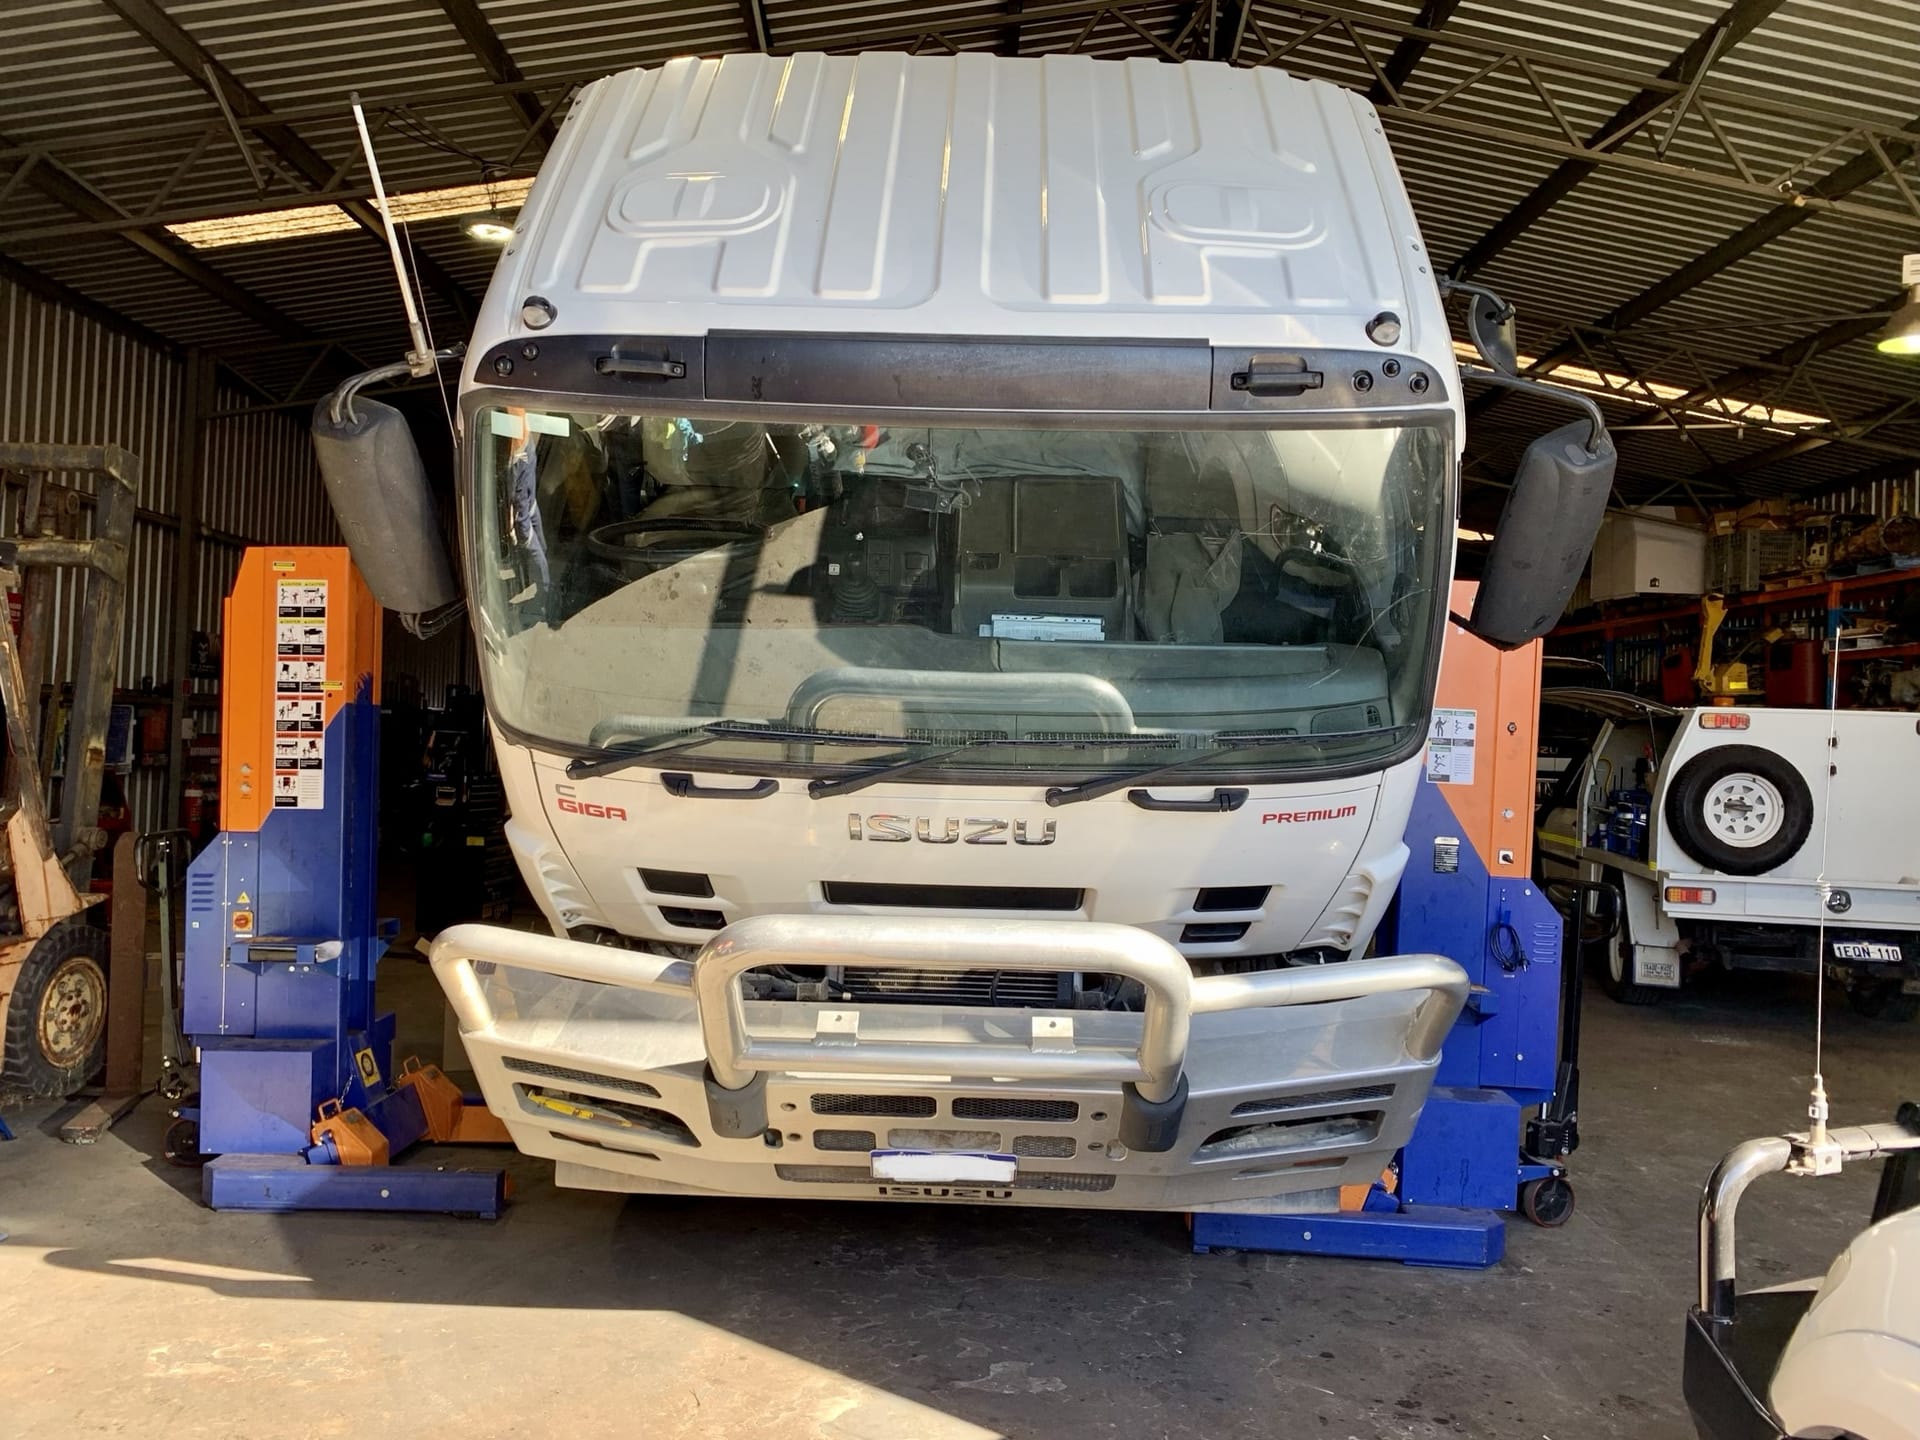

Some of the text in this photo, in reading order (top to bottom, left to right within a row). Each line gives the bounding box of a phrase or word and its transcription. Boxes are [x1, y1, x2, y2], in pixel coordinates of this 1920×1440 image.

[557, 798, 627, 821] GIGA
[1262, 806, 1357, 825] PREMIUM
[848, 813, 1057, 845] ISUZU
[878, 1187, 1013, 1199] ISUZU
